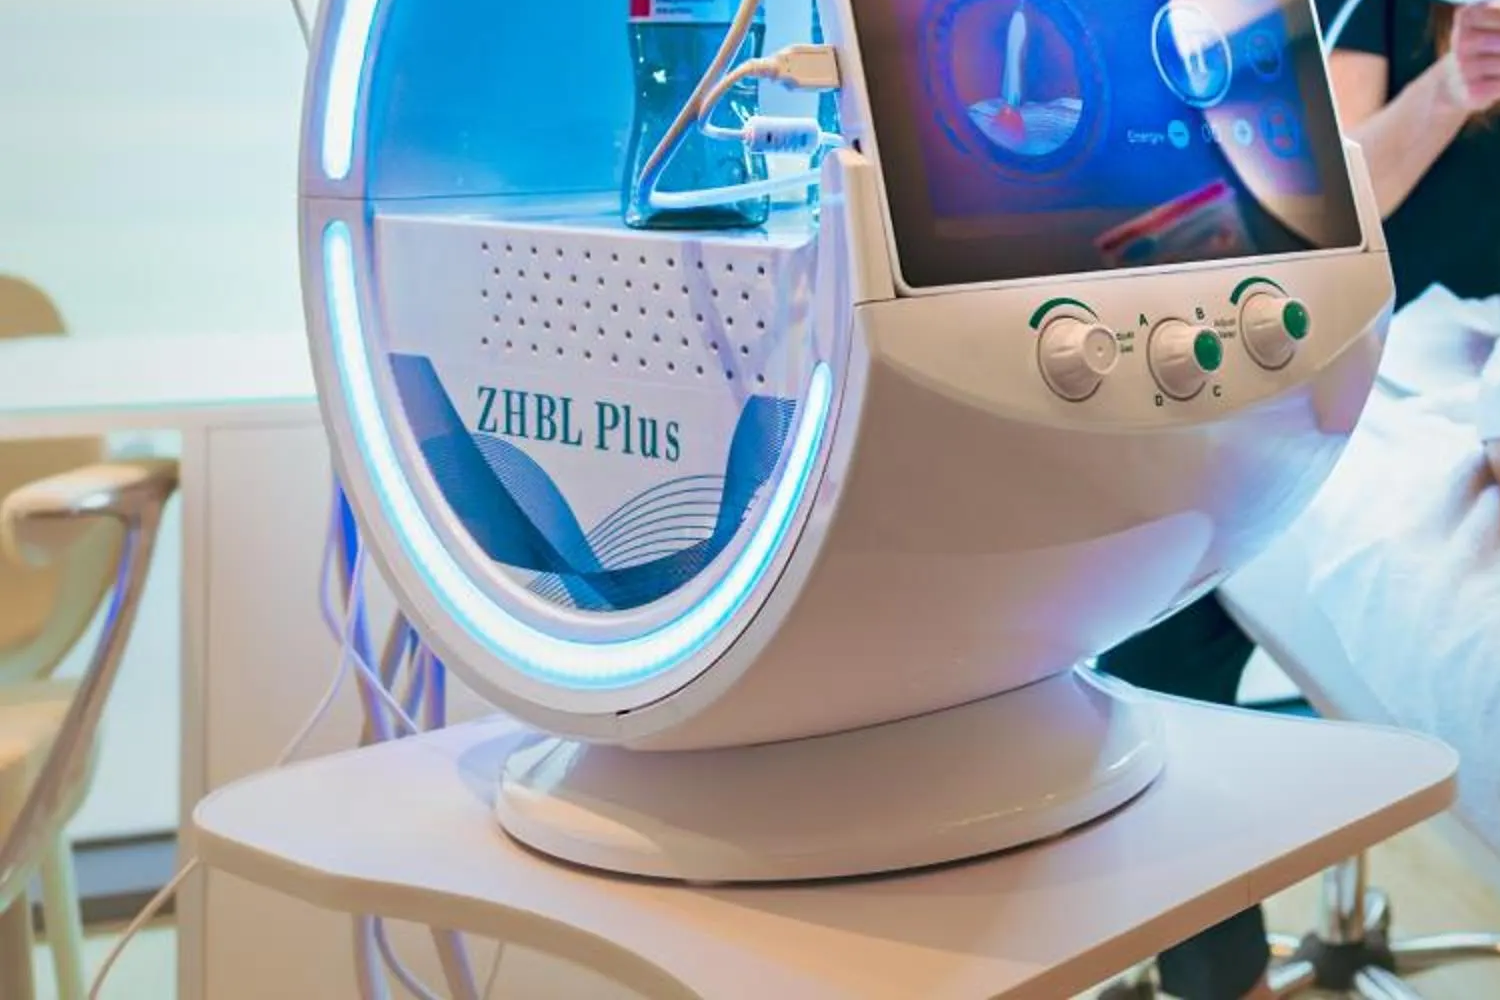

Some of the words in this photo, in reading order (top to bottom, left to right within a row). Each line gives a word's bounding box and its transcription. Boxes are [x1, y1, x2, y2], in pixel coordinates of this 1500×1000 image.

[1139, 313, 1149, 327] A
[1195, 307, 1205, 320] B
[1213, 385, 1221, 397] C
[1155, 395, 1163, 407] D
[477, 385, 584, 447] ZHBL
[594, 401, 682, 463] Plus
